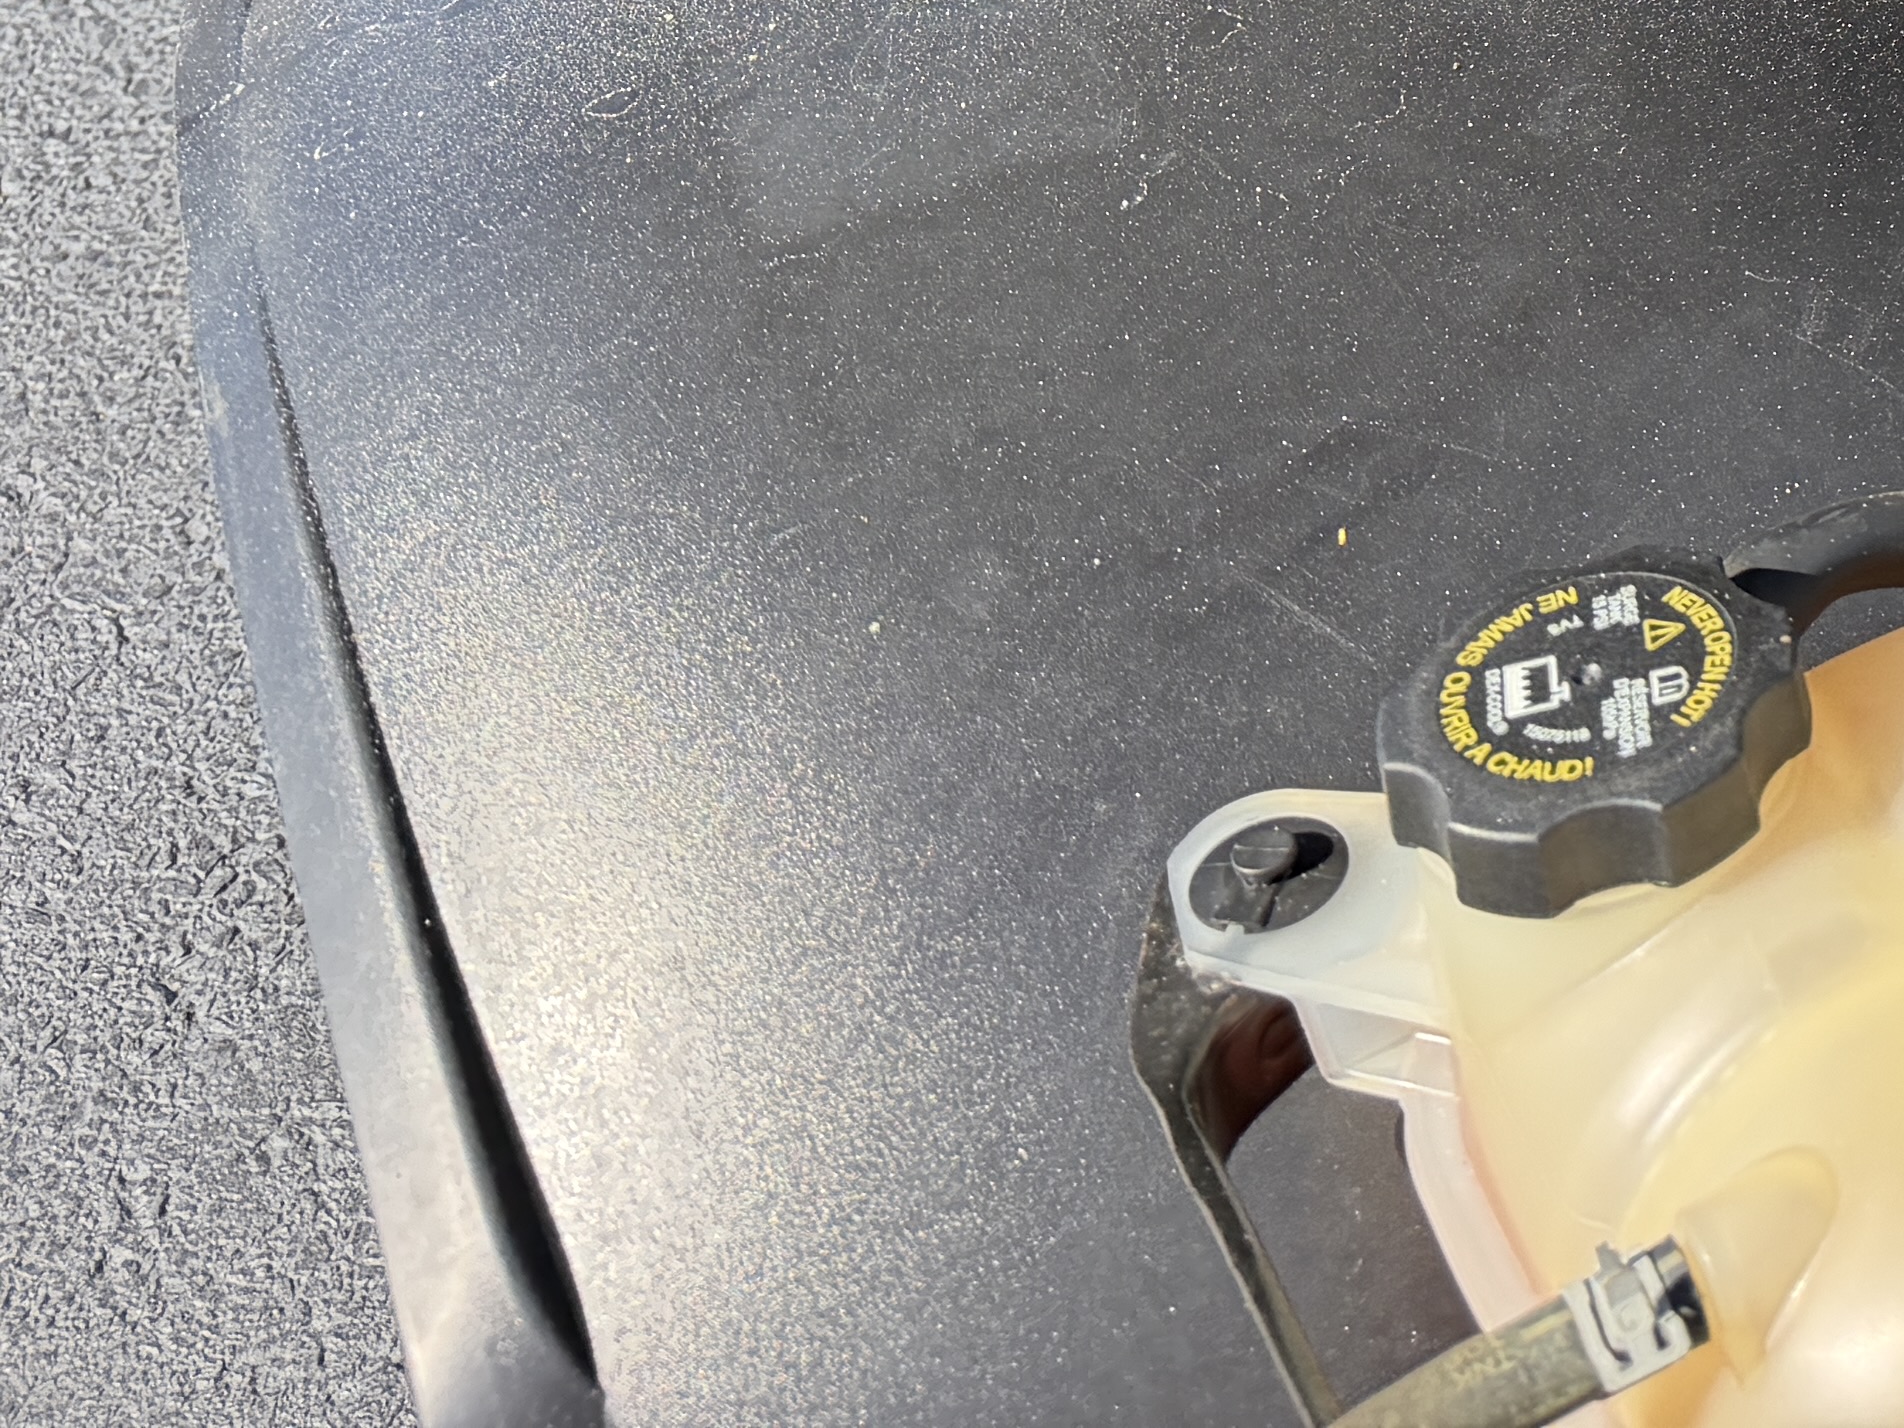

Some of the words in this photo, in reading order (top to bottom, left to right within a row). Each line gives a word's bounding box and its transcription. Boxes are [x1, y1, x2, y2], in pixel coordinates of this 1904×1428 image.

[1537, 585, 1579, 614] NE
[1661, 585, 1726, 632] NEVER
[1455, 600, 1533, 668] JAMAIS
[1702, 629, 1733, 676] OPEN
[1439, 671, 1478, 752] OUVRIR
[1670, 671, 1722, 728] HOT!
[1486, 751, 1594, 782] CHAUD!
